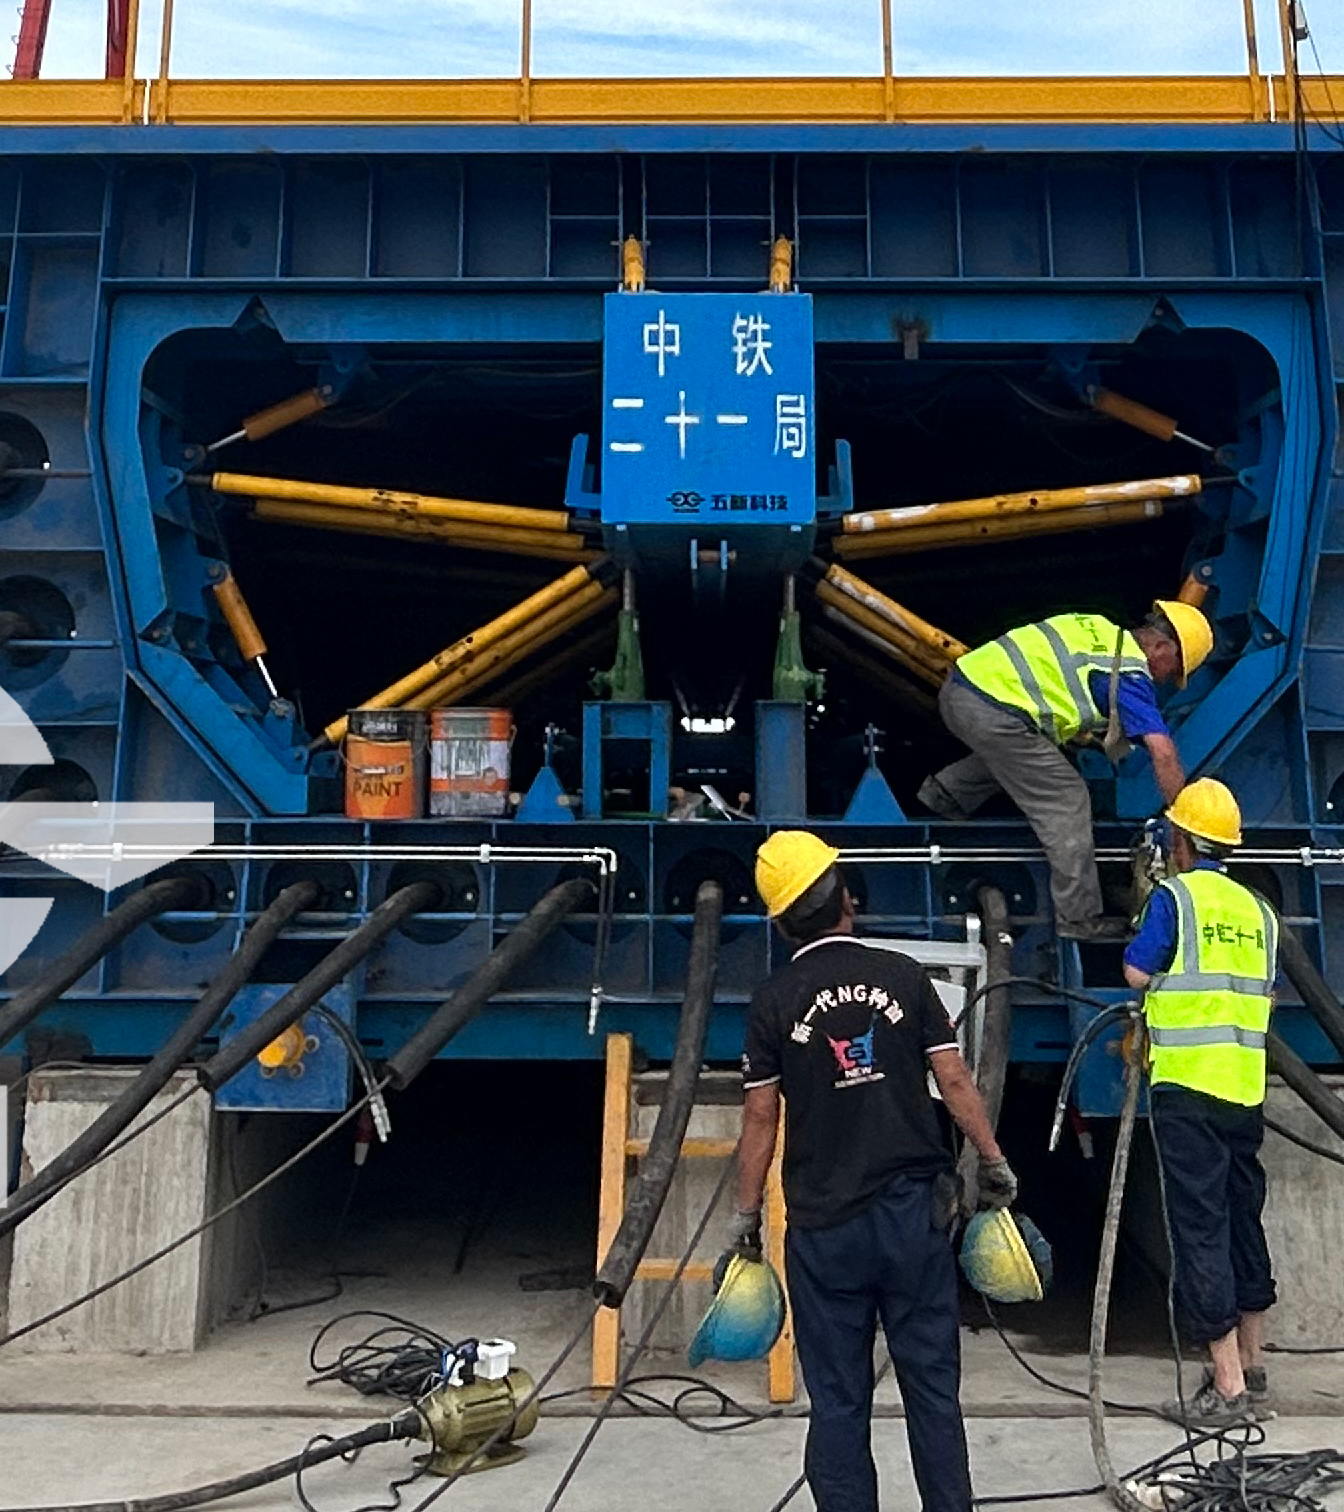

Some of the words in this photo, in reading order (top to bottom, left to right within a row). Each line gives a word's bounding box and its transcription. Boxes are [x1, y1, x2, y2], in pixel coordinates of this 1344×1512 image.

[642, 308, 774, 377] 中铁
[609, 390, 807, 459] 二十一局
[352, 780, 404, 798] PAINT
